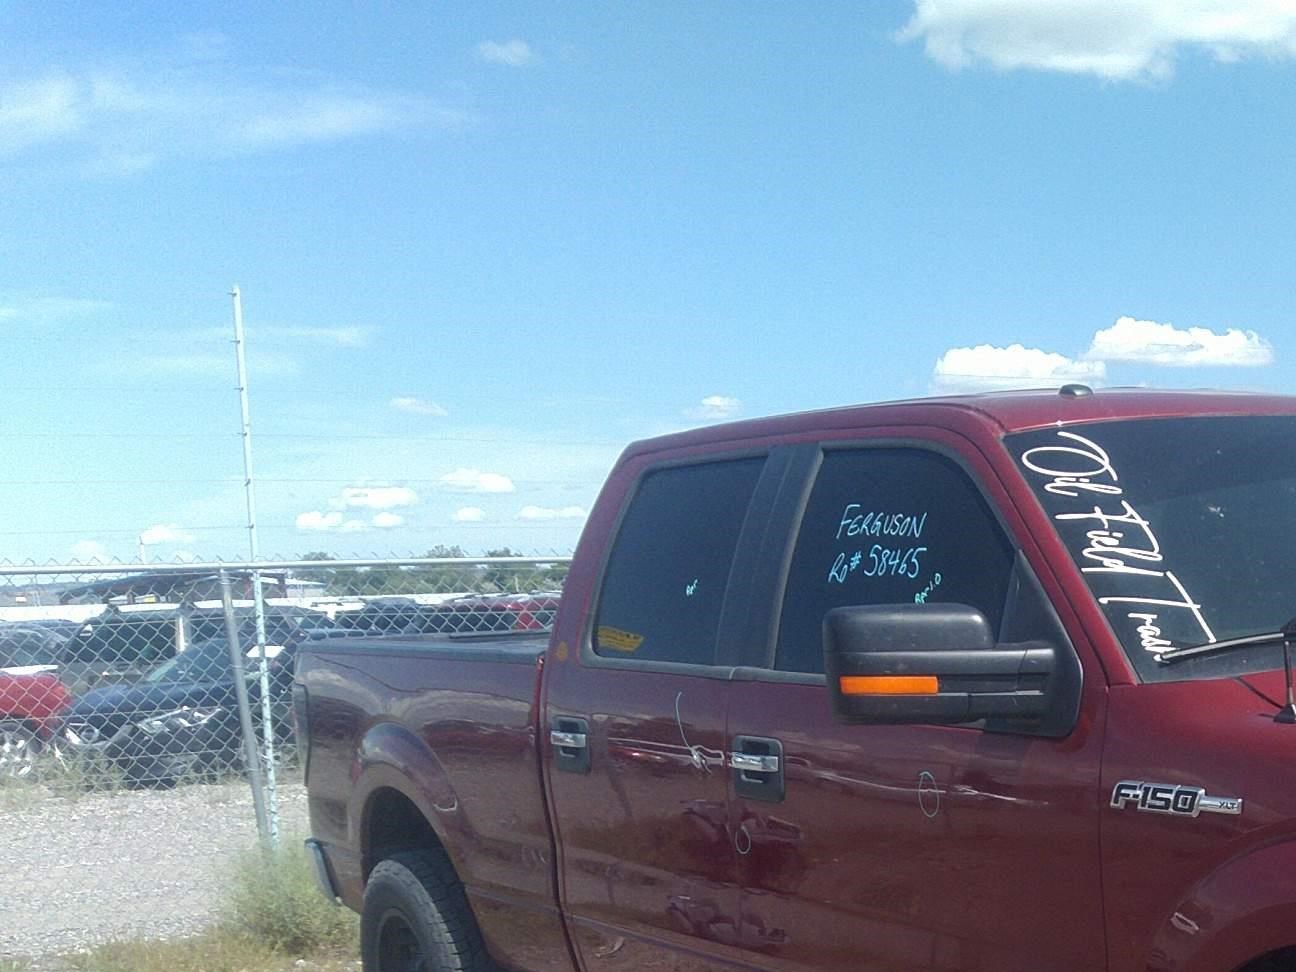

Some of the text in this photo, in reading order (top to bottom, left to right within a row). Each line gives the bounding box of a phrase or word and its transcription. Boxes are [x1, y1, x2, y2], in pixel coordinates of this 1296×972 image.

[1021, 431, 1123, 497] Oil
[835, 503, 928, 540] FERGUSON
[863, 544, 928, 579] 58465
[1111, 780, 1202, 816] F-150
